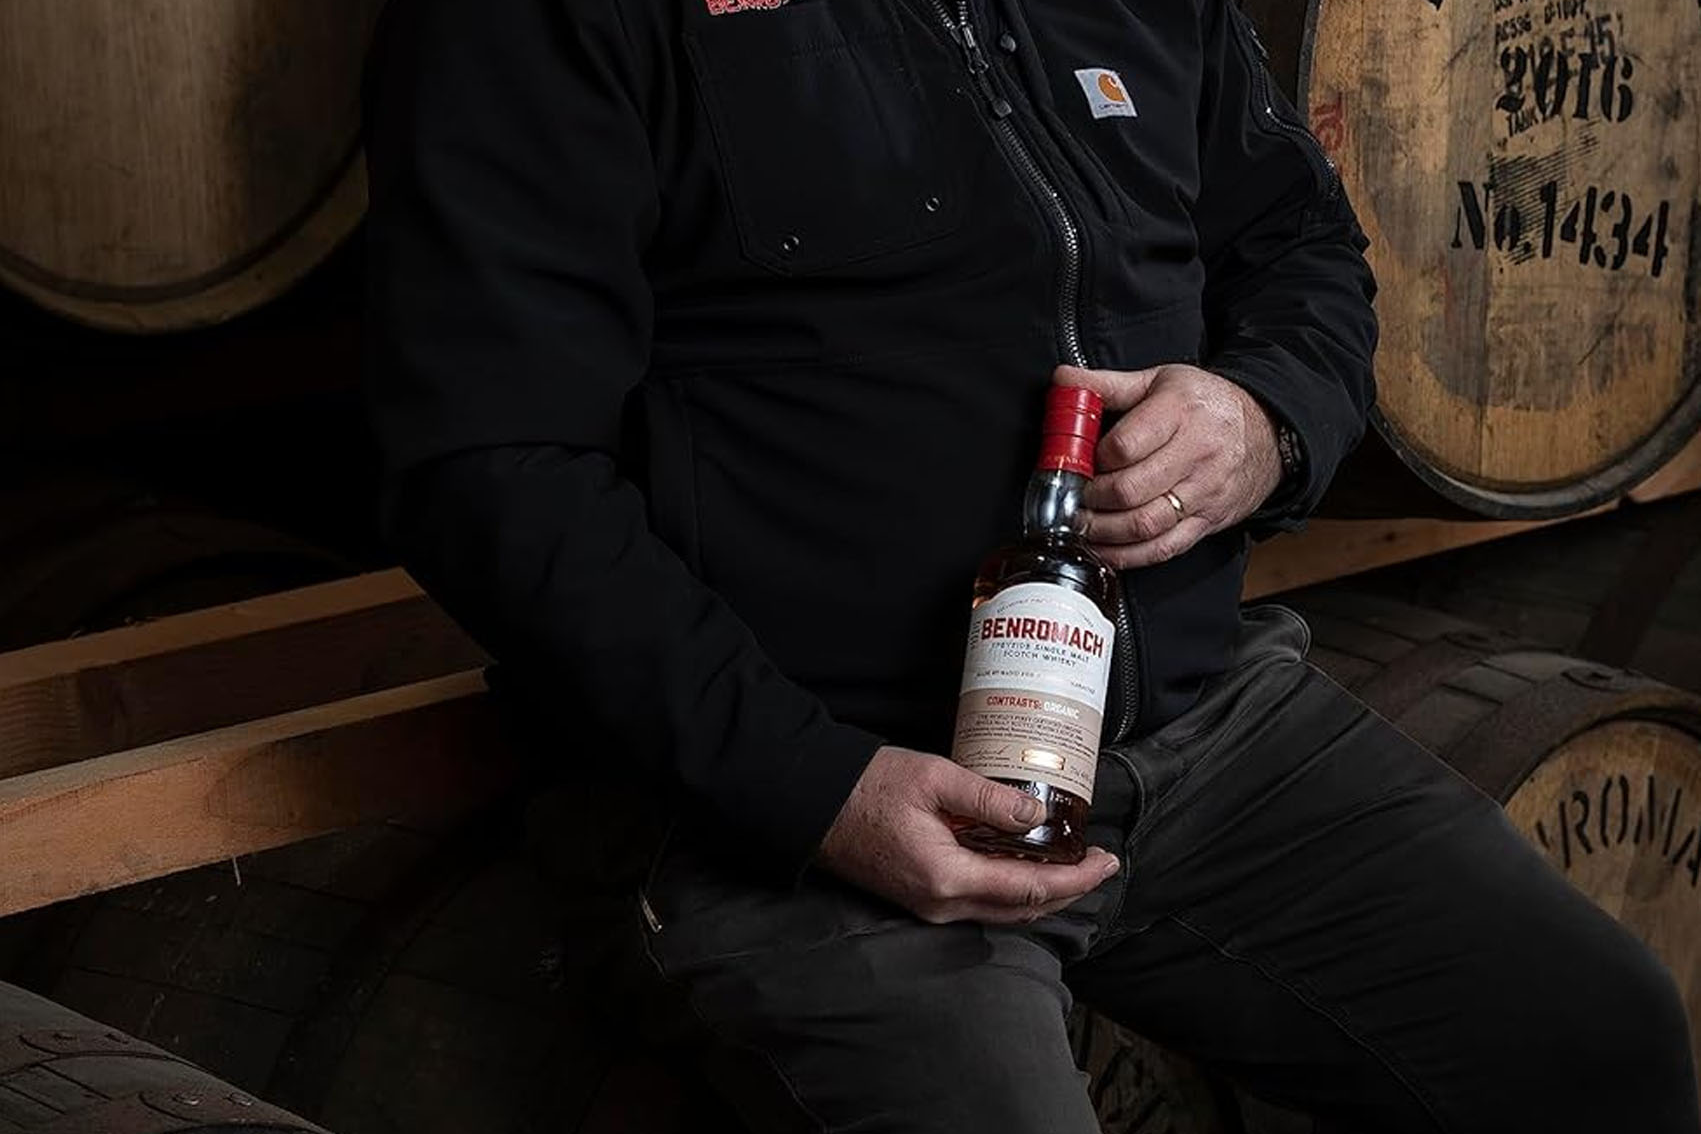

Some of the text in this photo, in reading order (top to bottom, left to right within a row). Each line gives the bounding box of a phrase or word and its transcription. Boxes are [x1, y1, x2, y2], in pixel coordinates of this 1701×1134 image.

[1495, 46, 1634, 124] 2016
[980, 616, 1105, 659] BENROMACH
[1002, 649, 1039, 659] SCOTCH
[986, 695, 1042, 710] CONTRASTS:
[1536, 774, 1701, 888] ROMA
